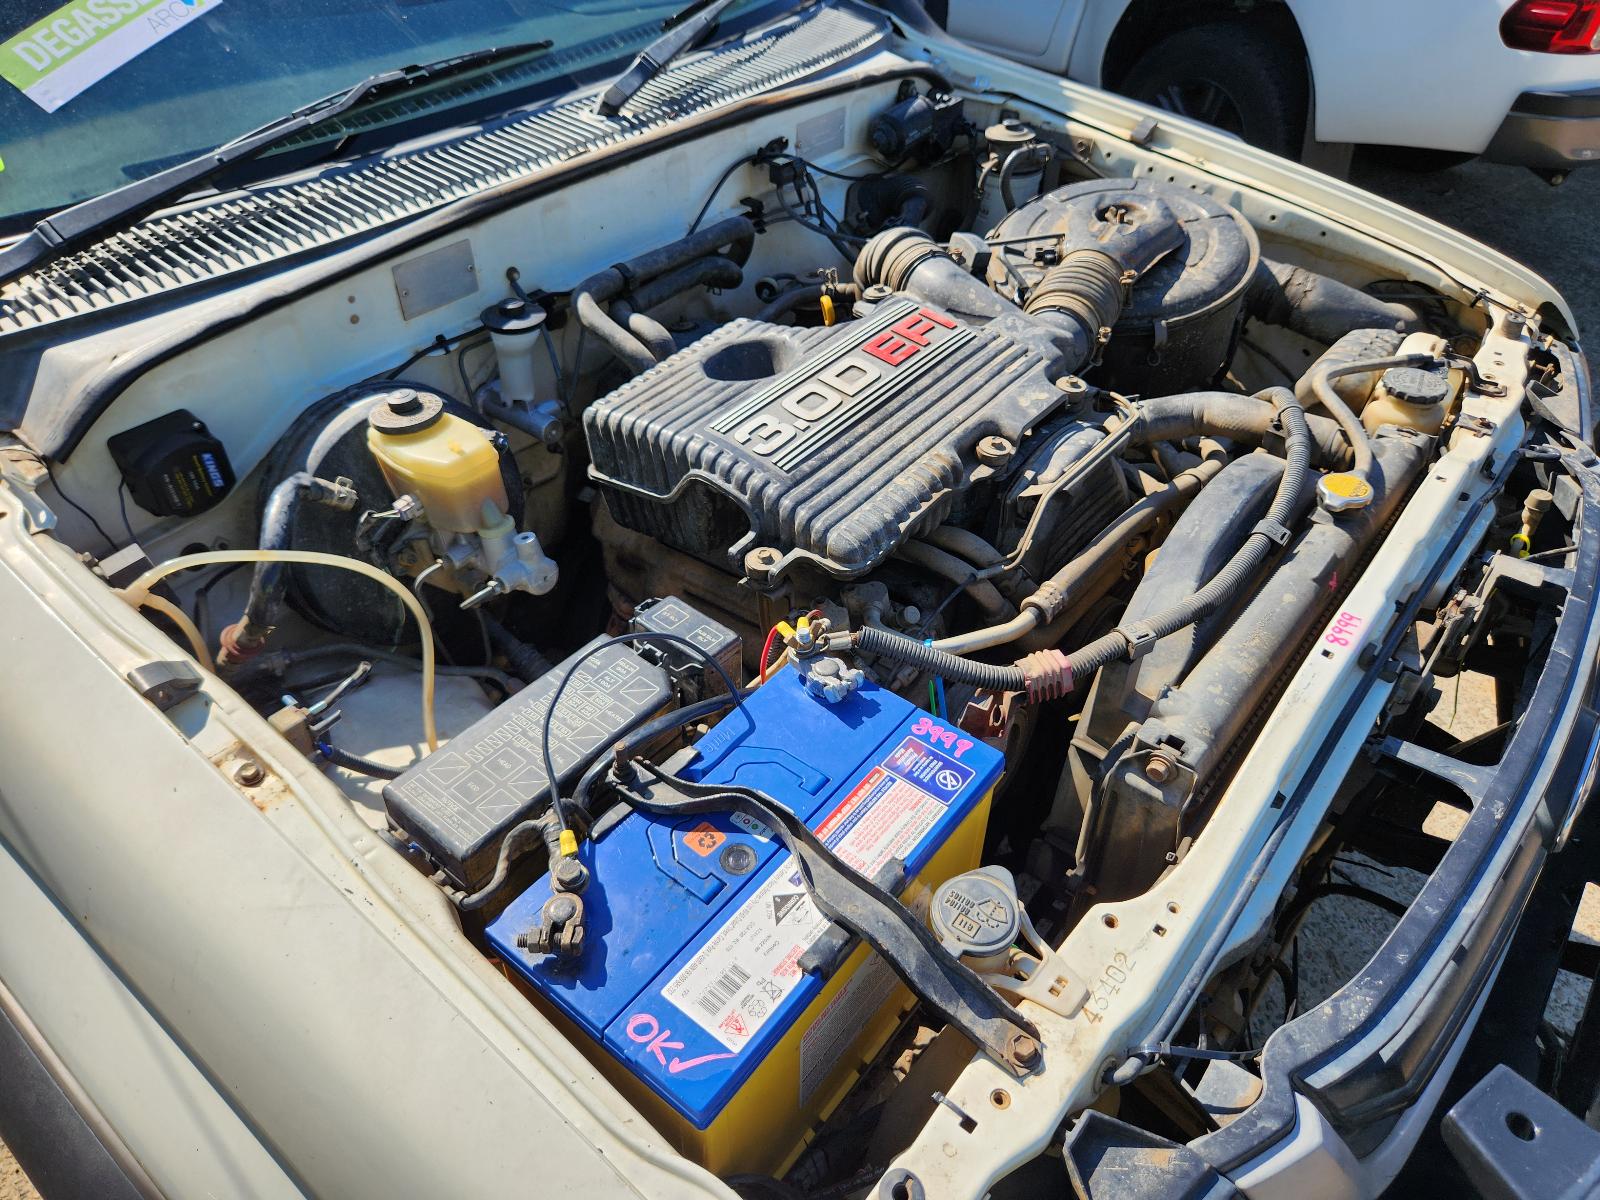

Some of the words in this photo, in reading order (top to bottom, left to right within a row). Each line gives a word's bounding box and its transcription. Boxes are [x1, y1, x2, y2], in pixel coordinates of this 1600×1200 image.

[734, 356, 882, 456] 3.0D
[862, 307, 958, 367] EFI
[626, 1013, 684, 1066] OK
